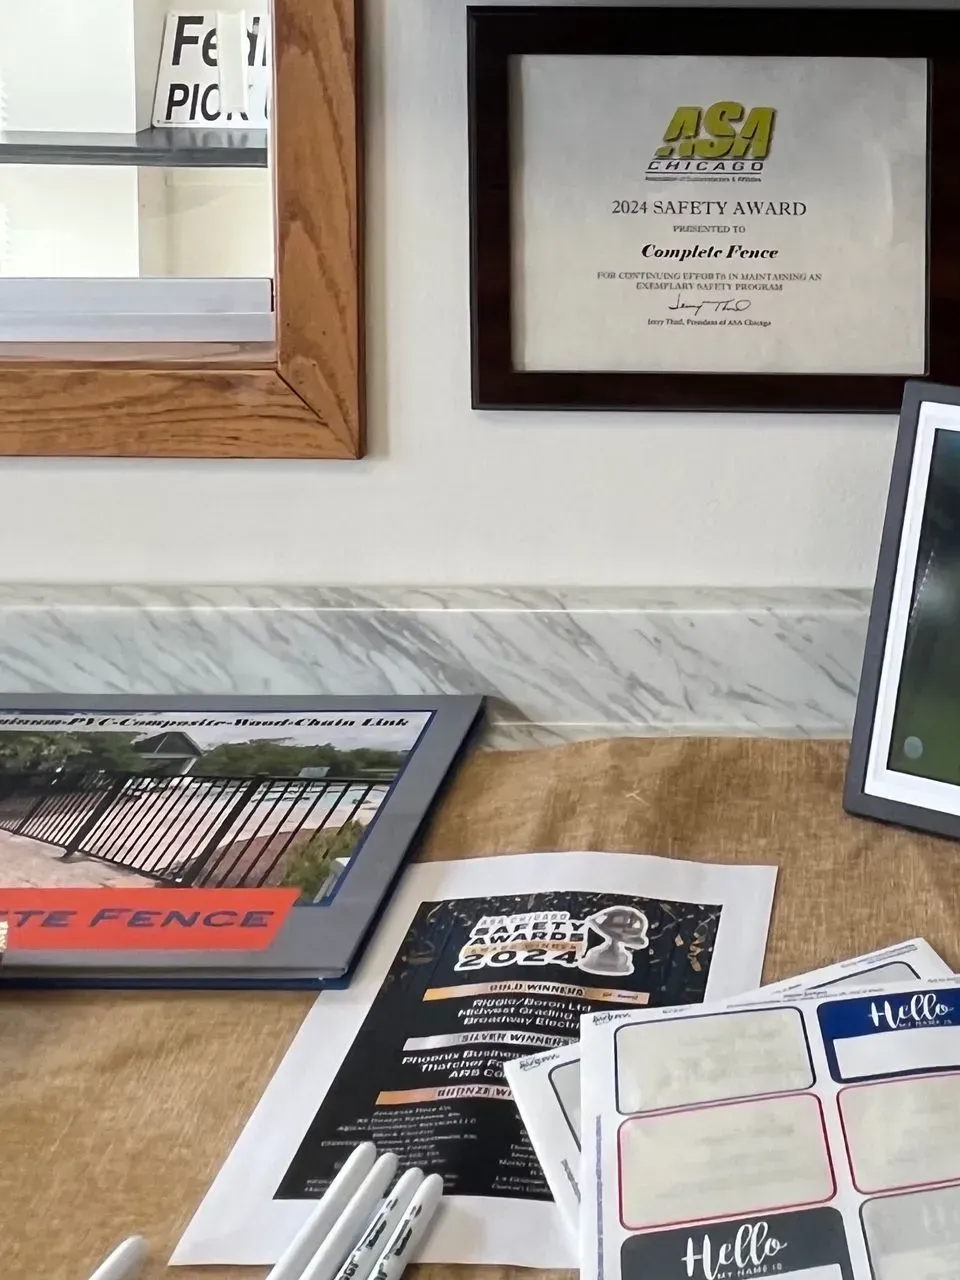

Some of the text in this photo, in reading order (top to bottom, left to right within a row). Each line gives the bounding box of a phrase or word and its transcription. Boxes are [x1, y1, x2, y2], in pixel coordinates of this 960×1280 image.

[165, 83, 249, 121] PIC
[652, 100, 778, 160] ASA
[647, 160, 764, 171] CHICAGO
[611, 200, 807, 216] 2024 SAFETY AWARD
[673, 224, 746, 234] PRESENTED TO
[641, 243, 779, 262] Complete Fence
[597, 271, 822, 281] FOR CONTINUING EFFORTS IN MAINTAINING AN
[636, 282, 783, 291] EXEMPLARY SAFETY PROGRAM
[361, 717, 409, 727] Link
[0, 907, 275, 928] TE FENCE
[474, 921, 585, 936] SAFETY
[470, 931, 584, 946] AWARDS
[459, 949, 579, 968] 2024
[527, 984, 584, 997] WINNERS
[457, 1006, 515, 1018] Midwest
[868, 993, 955, 1029] Hello
[463, 1015, 533, 1026] Broadway
[536, 1017, 580, 1030] Electri
[681, 1221, 788, 1280] Hello
[737, 1265, 768, 1278] NAME
